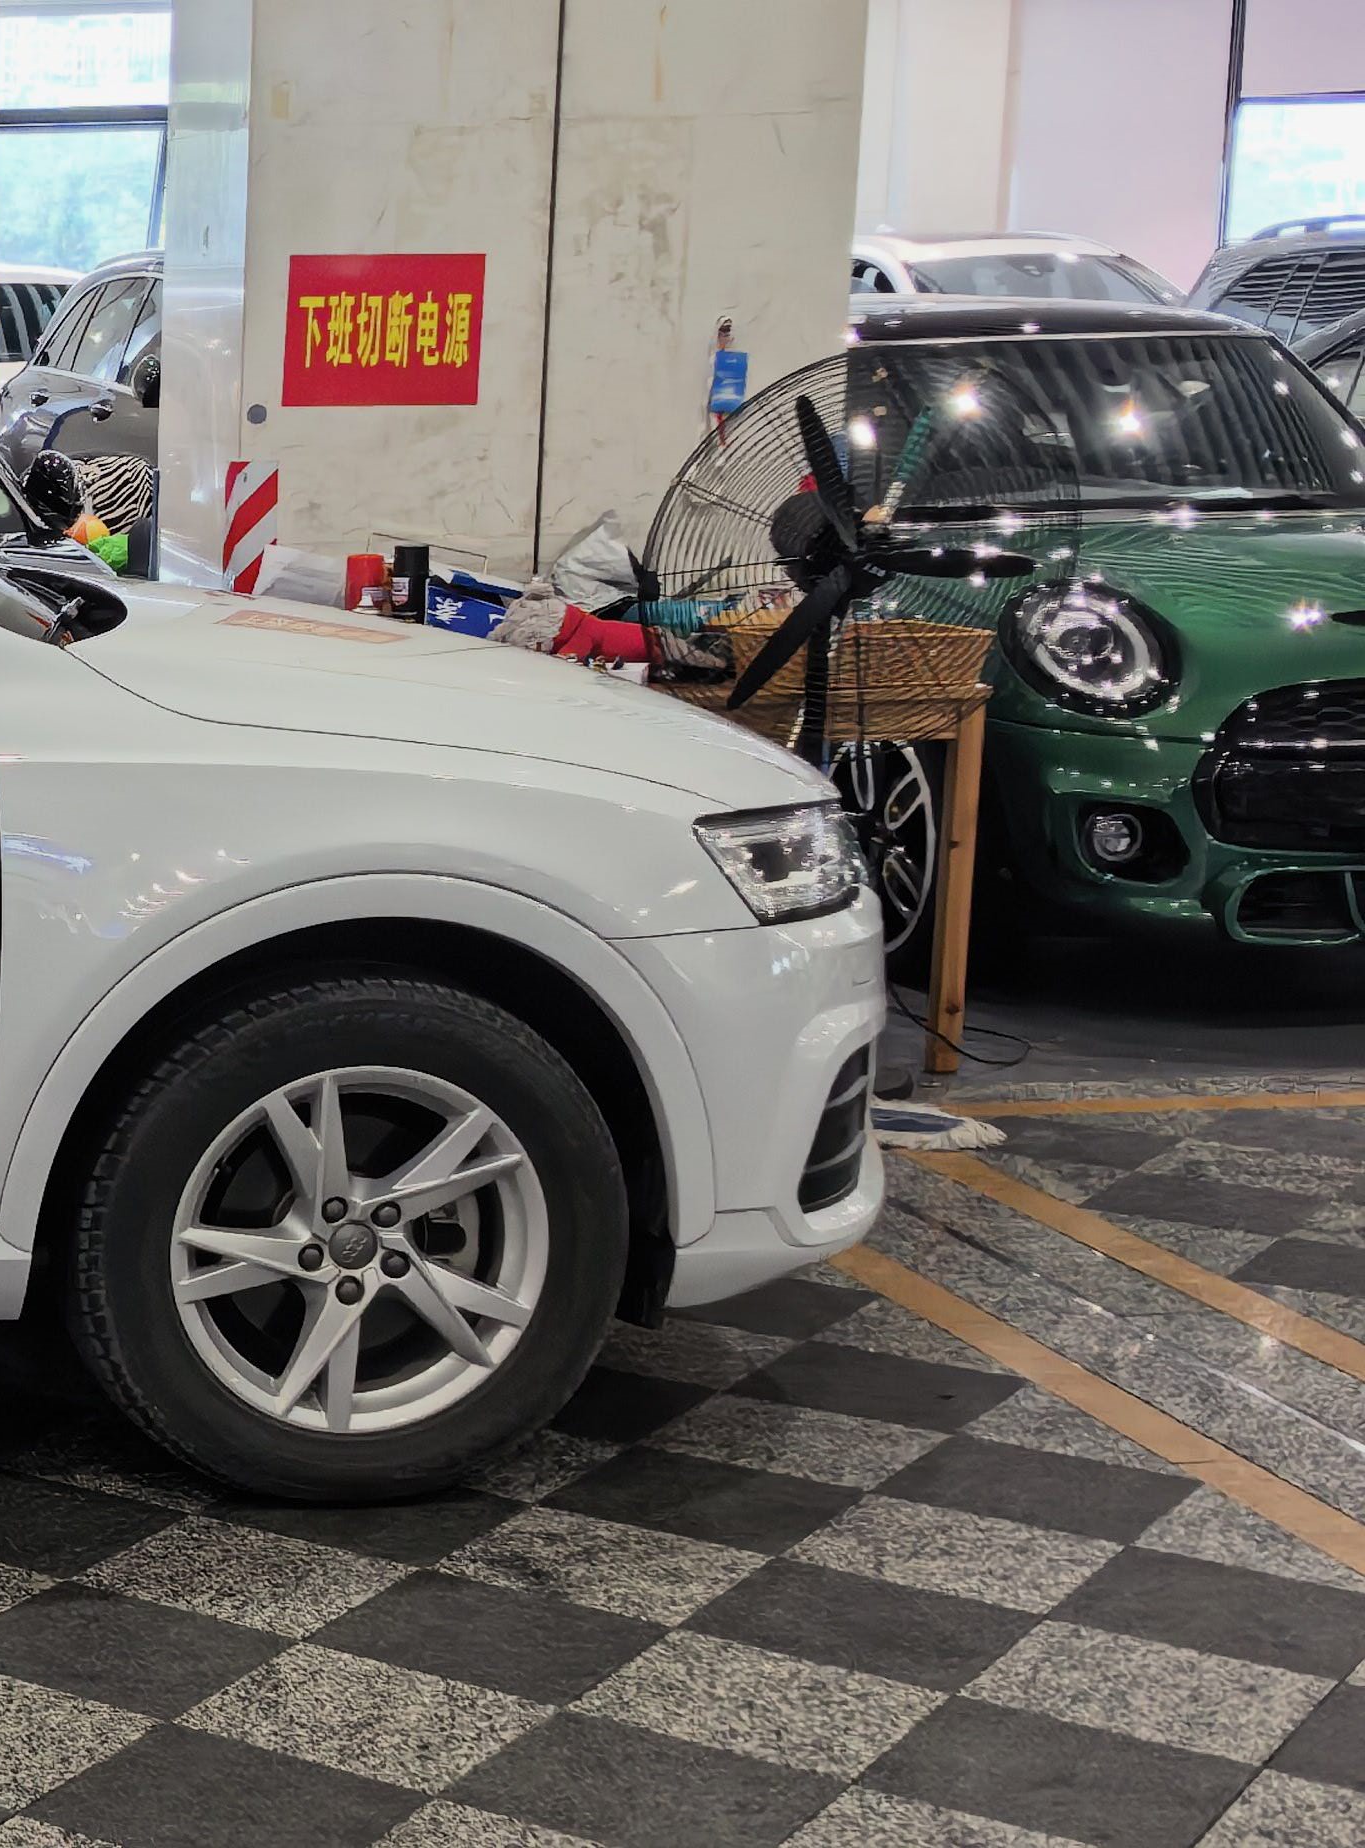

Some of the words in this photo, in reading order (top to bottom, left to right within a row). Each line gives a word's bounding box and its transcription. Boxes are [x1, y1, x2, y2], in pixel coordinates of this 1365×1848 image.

[299, 290, 473, 368] 下班切断电源
